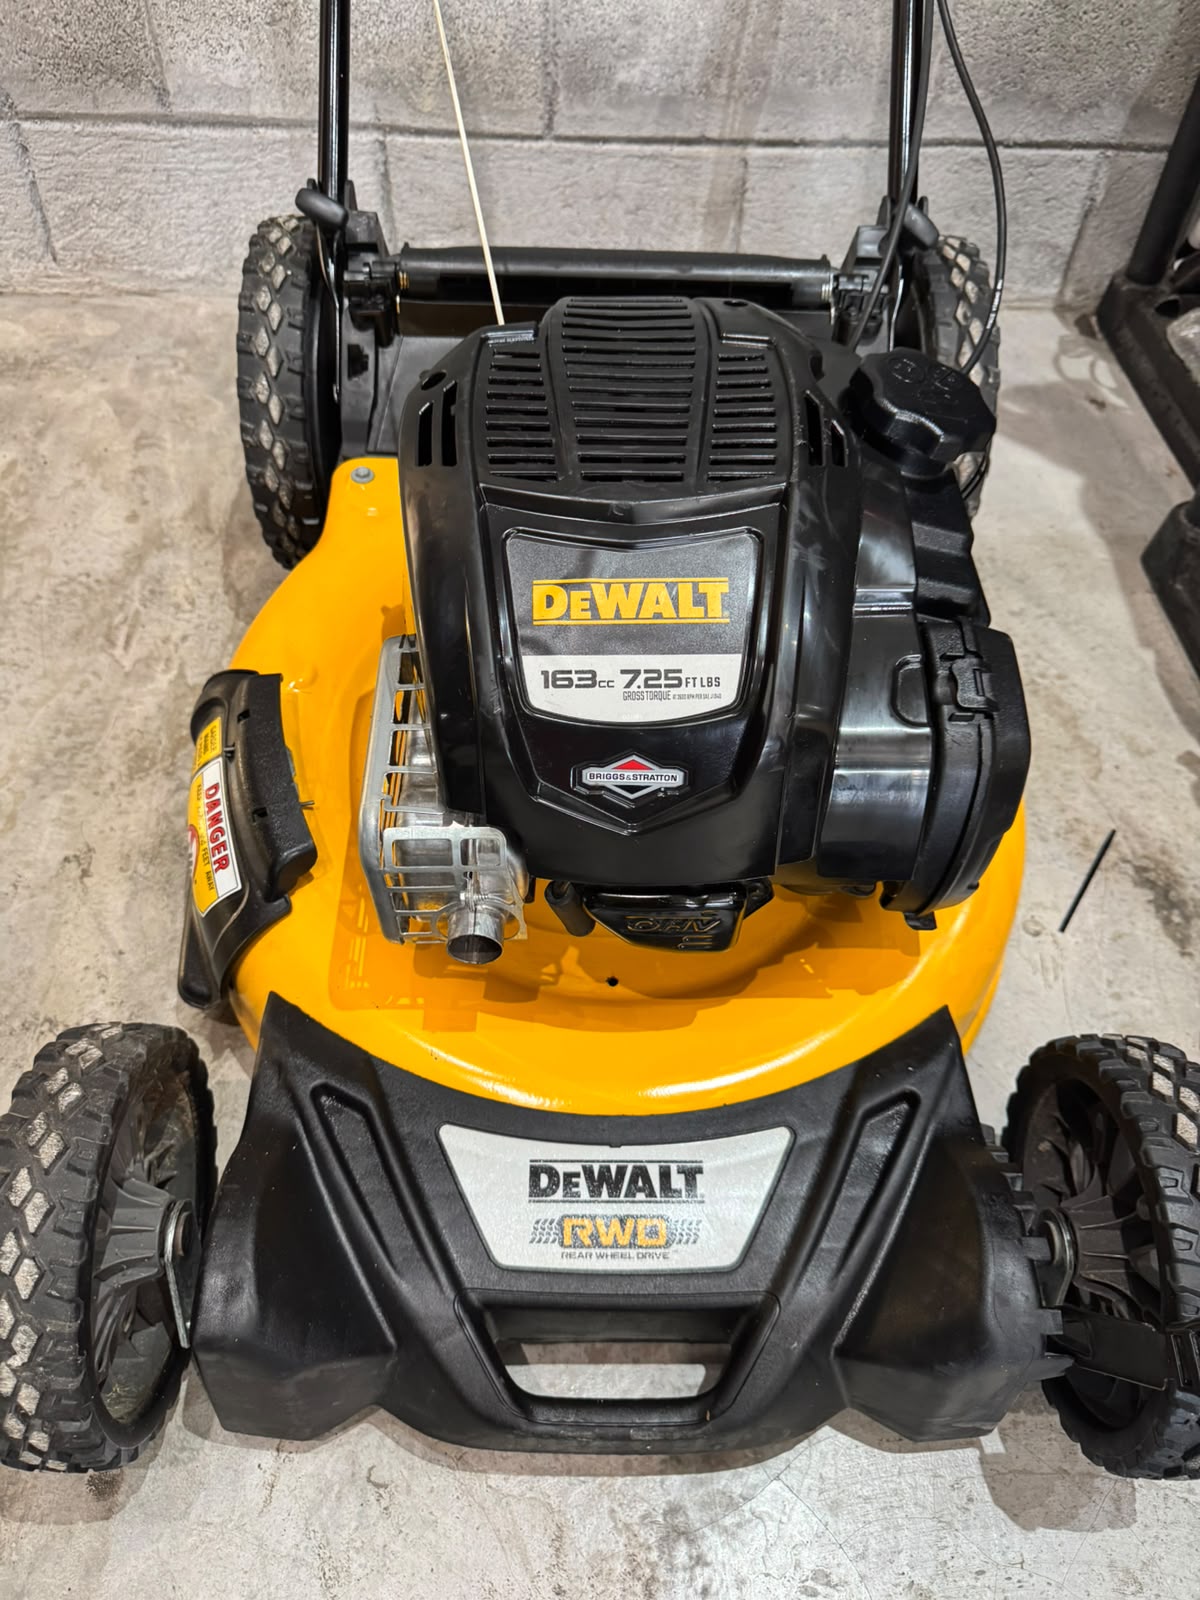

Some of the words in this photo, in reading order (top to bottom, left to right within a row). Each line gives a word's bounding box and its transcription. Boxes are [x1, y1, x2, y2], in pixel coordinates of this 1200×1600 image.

[620, 668, 683, 689] 7.25
[685, 676, 698, 688] FT
[700, 676, 721, 688] LBS
[622, 690, 645, 701] GROSS
[645, 690, 671, 702] TORQUE
[204, 782, 230, 873] DANGER
[202, 847, 210, 867] FEET
[206, 871, 215, 891] AWAY
[562, 1217, 668, 1247] RWD
[561, 1251, 593, 1260] REAR
[595, 1251, 635, 1260] WHEEL
[637, 1251, 670, 1260] DRIVE
